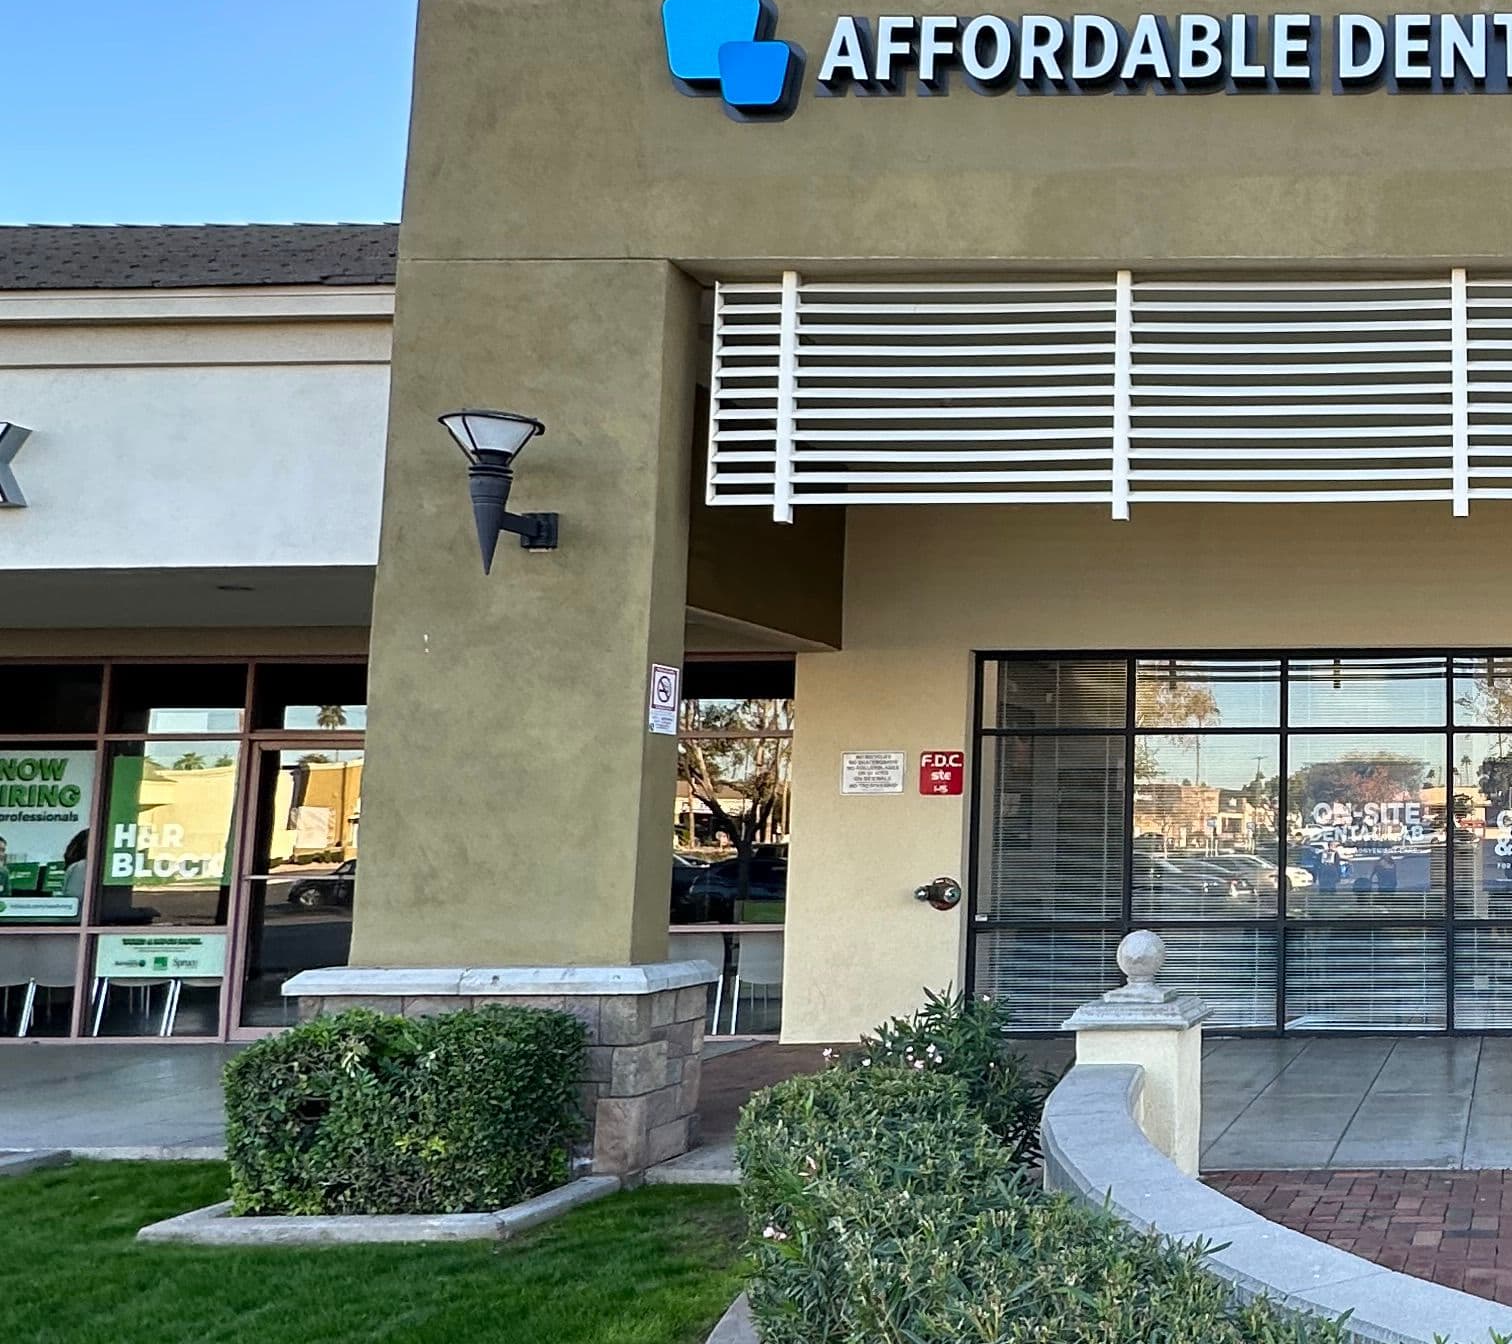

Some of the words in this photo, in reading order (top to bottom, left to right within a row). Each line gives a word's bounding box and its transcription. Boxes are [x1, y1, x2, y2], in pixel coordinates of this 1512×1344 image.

[817, 13, 1311, 81] AFFORDABLE
[0, 758, 69, 782] NOW
[921, 754, 962, 767] F.D.C.
[0, 784, 81, 807] IRING
[1312, 803, 1421, 825] ON-SITE
[113, 824, 184, 848] H&R
[1495, 837, 1512, 856] &
[111, 853, 223, 879] BLOCK
